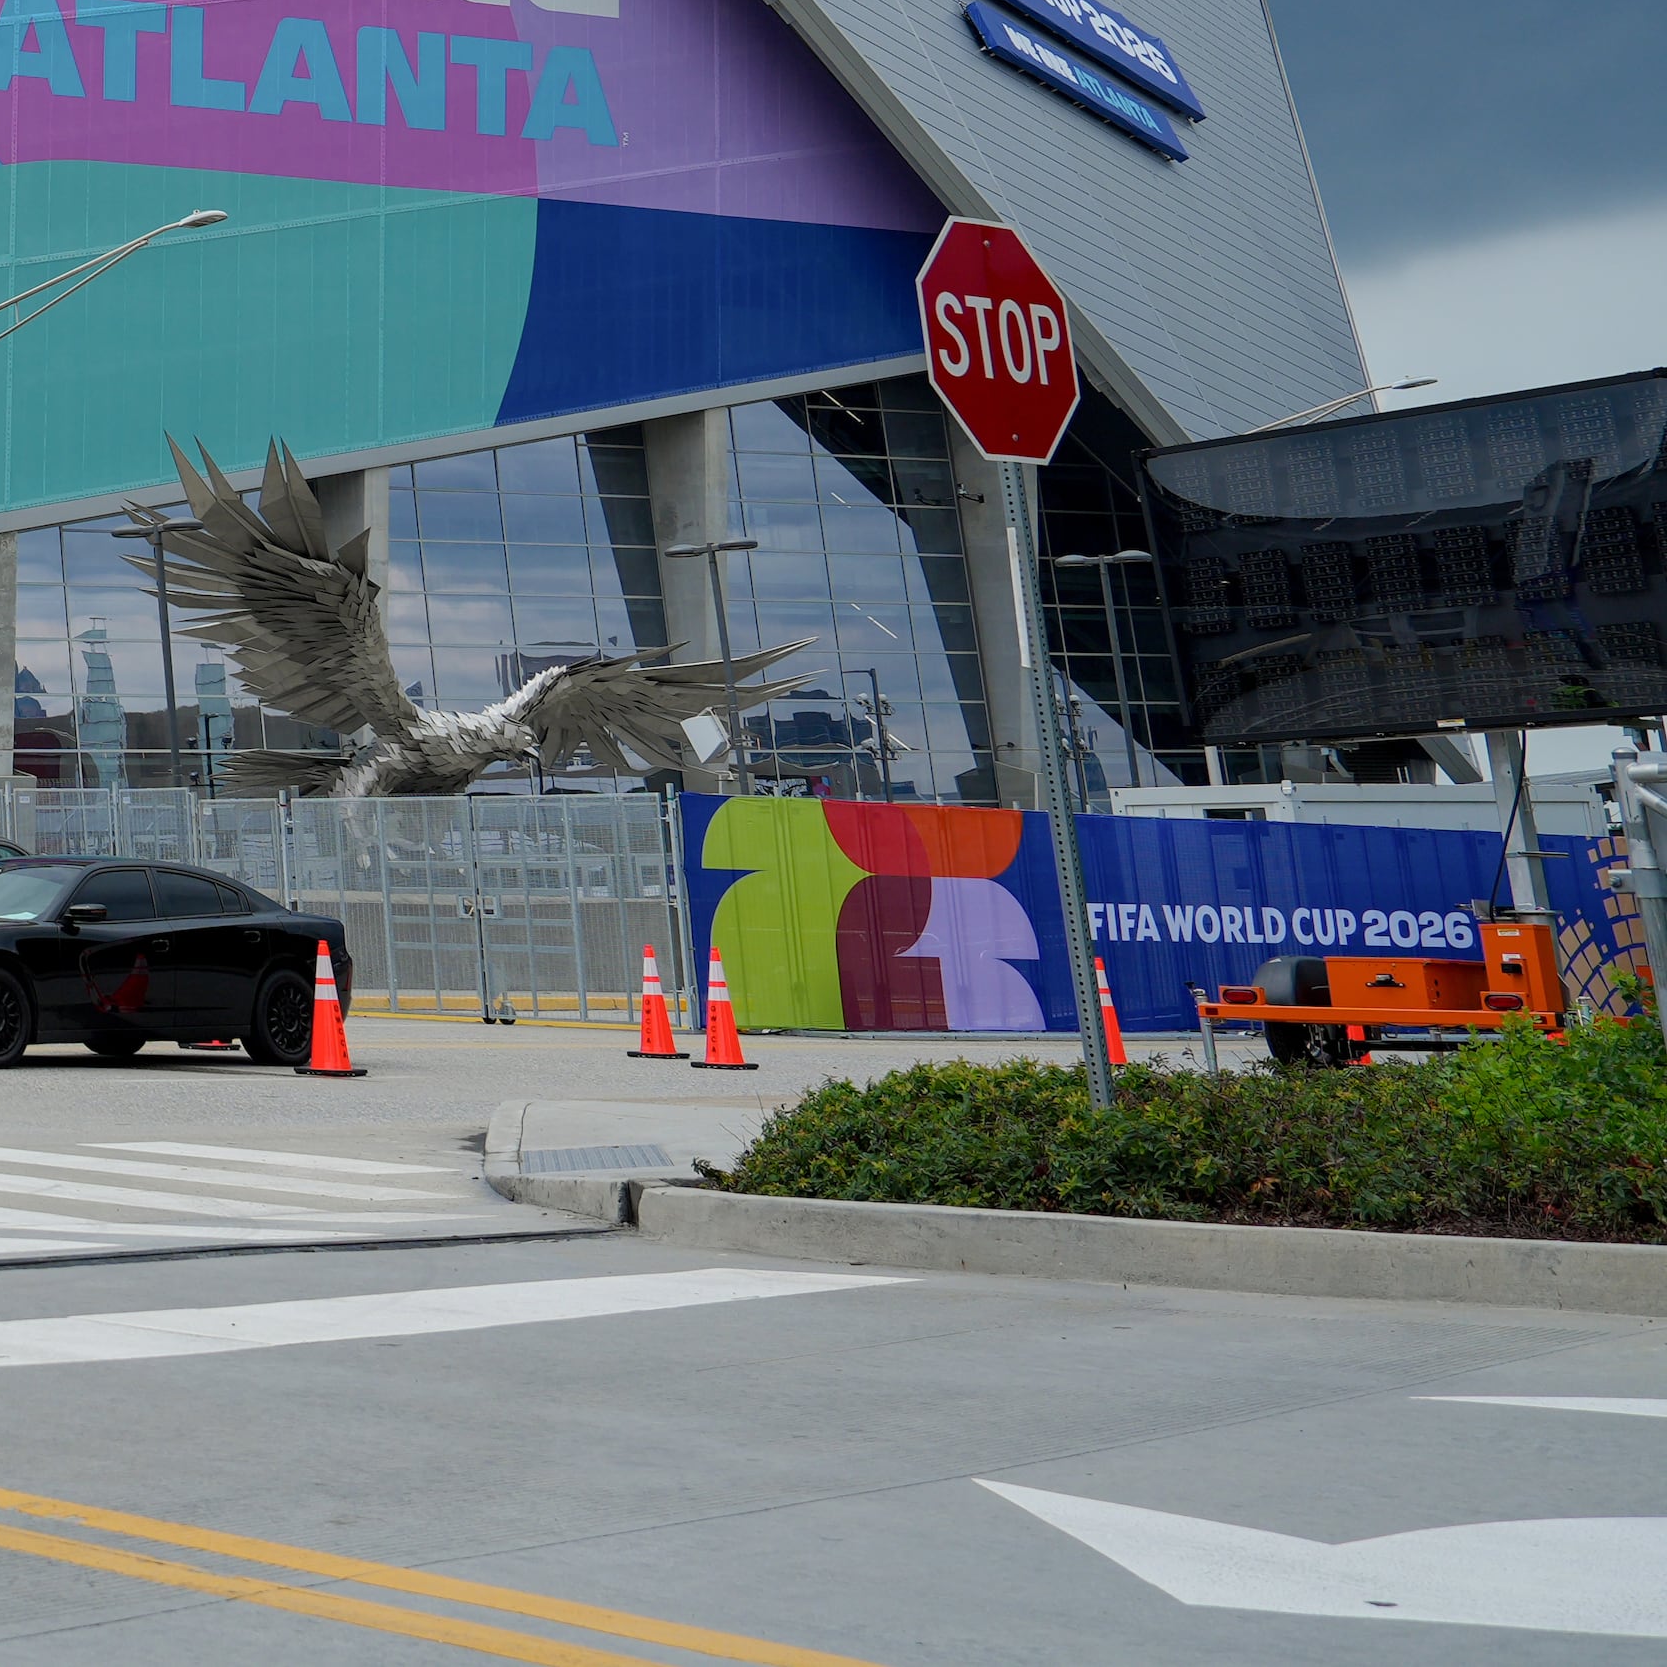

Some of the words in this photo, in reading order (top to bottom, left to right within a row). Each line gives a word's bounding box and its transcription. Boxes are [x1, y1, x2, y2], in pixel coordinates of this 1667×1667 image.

[1079, 0, 1178, 84] 2026
[1073, 66, 1162, 133] ATLANTA
[935, 291, 1061, 385] STOP
[1086, 903, 1161, 942] FIFA
[1162, 904, 1286, 945] WORLD
[1292, 907, 1357, 946] CUP
[1362, 910, 1474, 949] 2026
